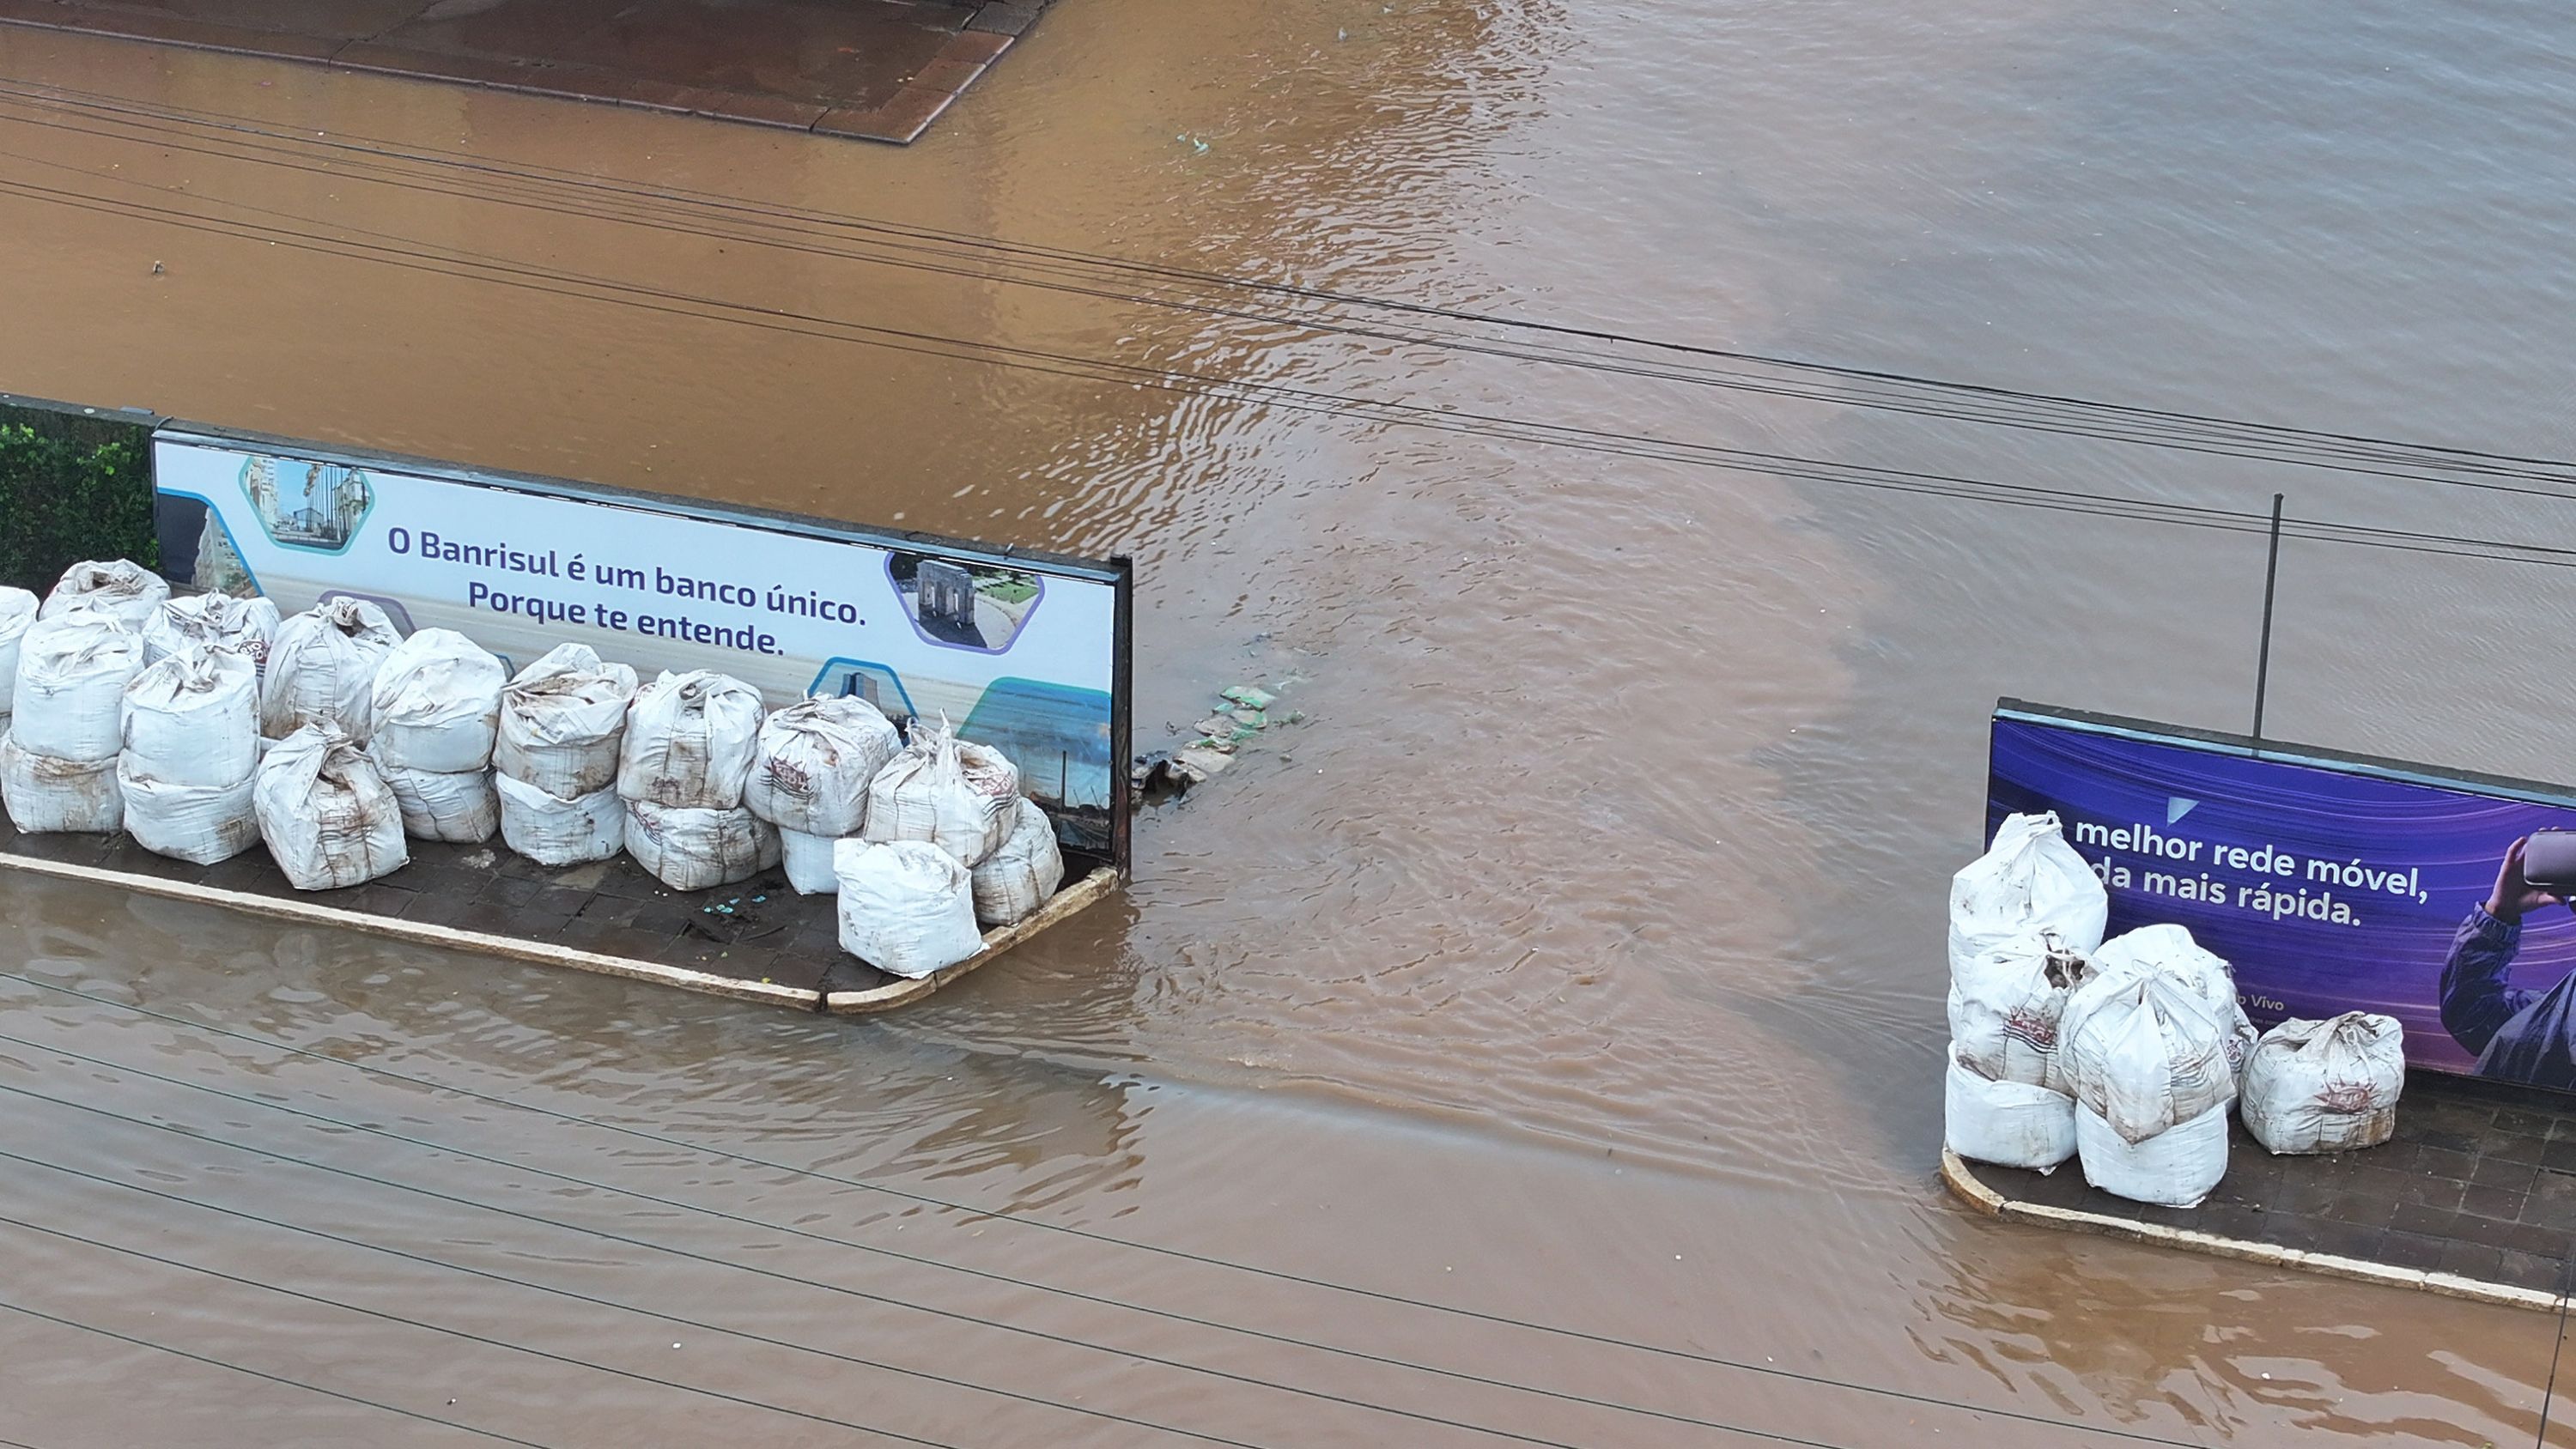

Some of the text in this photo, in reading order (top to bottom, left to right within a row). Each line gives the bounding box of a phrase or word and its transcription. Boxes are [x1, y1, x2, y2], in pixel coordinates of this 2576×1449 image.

[388, 527, 866, 626] O Banrisul é um banco único.
[469, 582, 784, 656] Porque te entende.
[2076, 822, 2428, 905] melhor rede móvel,
[2143, 871, 2227, 904] mais
[2238, 882, 2361, 926] rápida.
[2251, 994, 2285, 1011] Vivo
